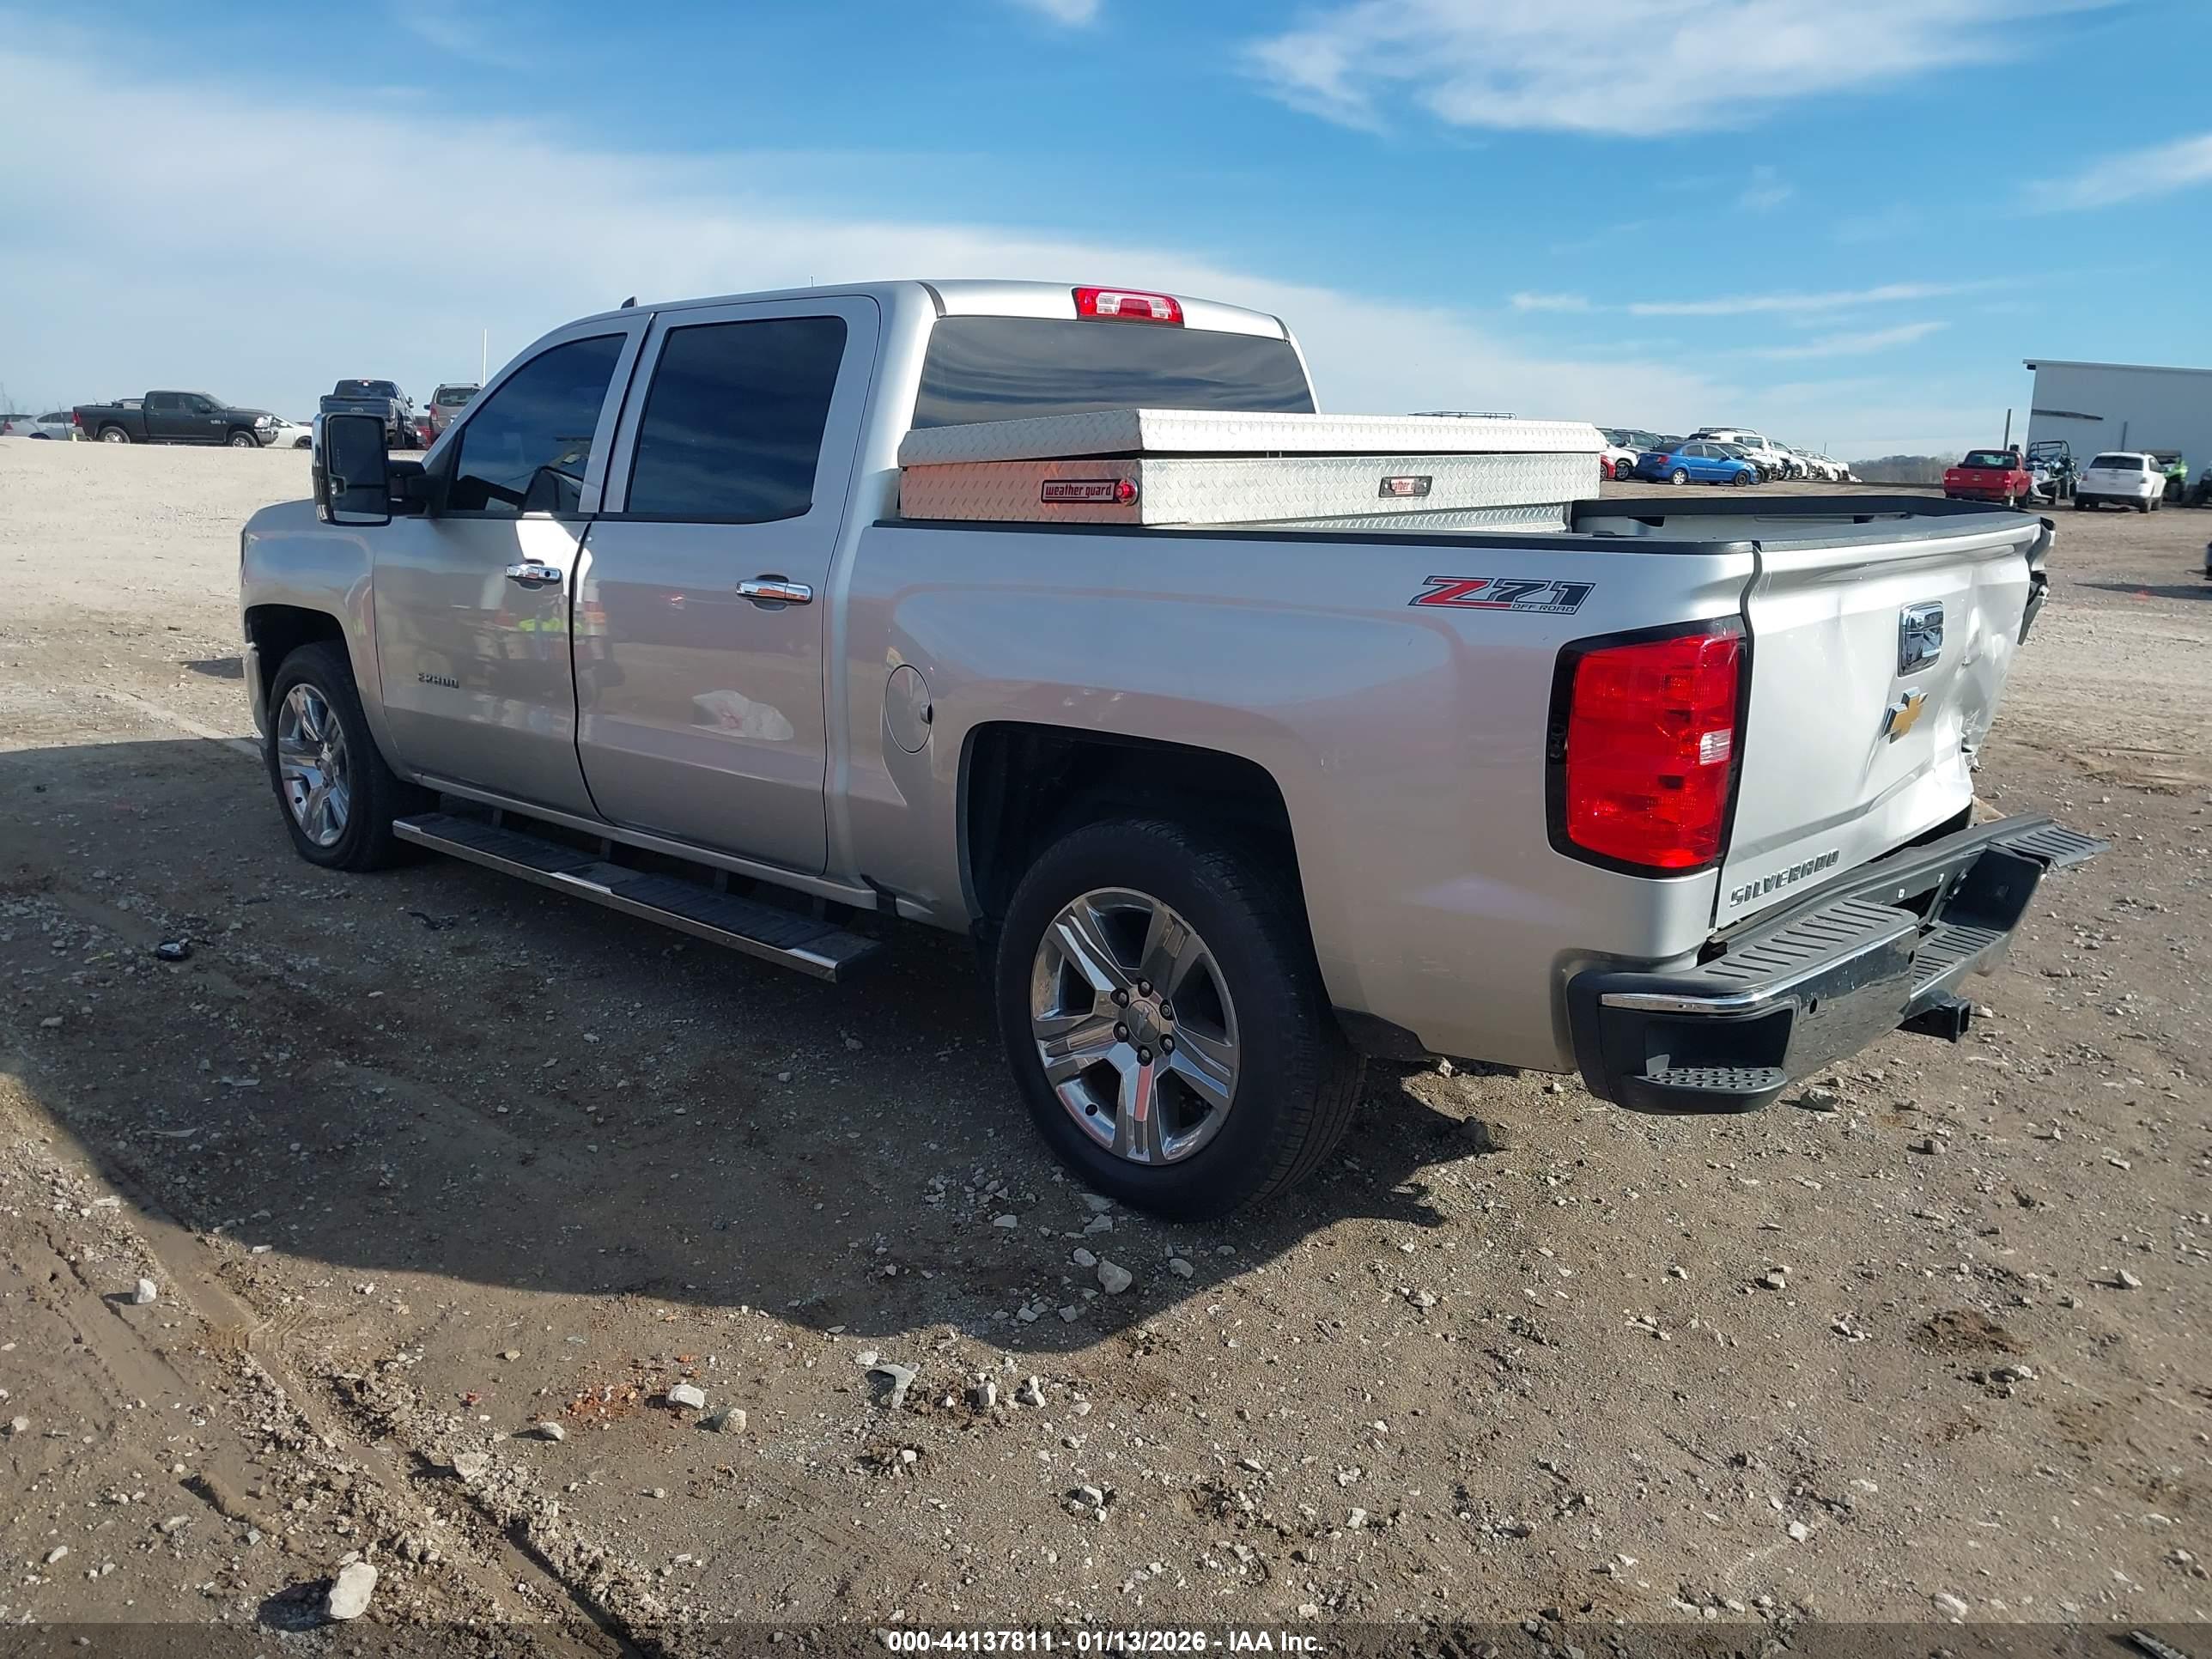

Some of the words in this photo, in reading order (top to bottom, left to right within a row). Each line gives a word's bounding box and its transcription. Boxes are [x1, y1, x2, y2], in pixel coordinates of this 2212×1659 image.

[1045, 483, 1083, 495] weather
[1085, 483, 1111, 498] guard
[1391, 480, 1410, 491] eather
[1408, 575, 1595, 611] Z71
[1511, 603, 1537, 611] OFF
[1538, 605, 1574, 613] ROAD
[1729, 848, 1840, 907] SILVERADO
